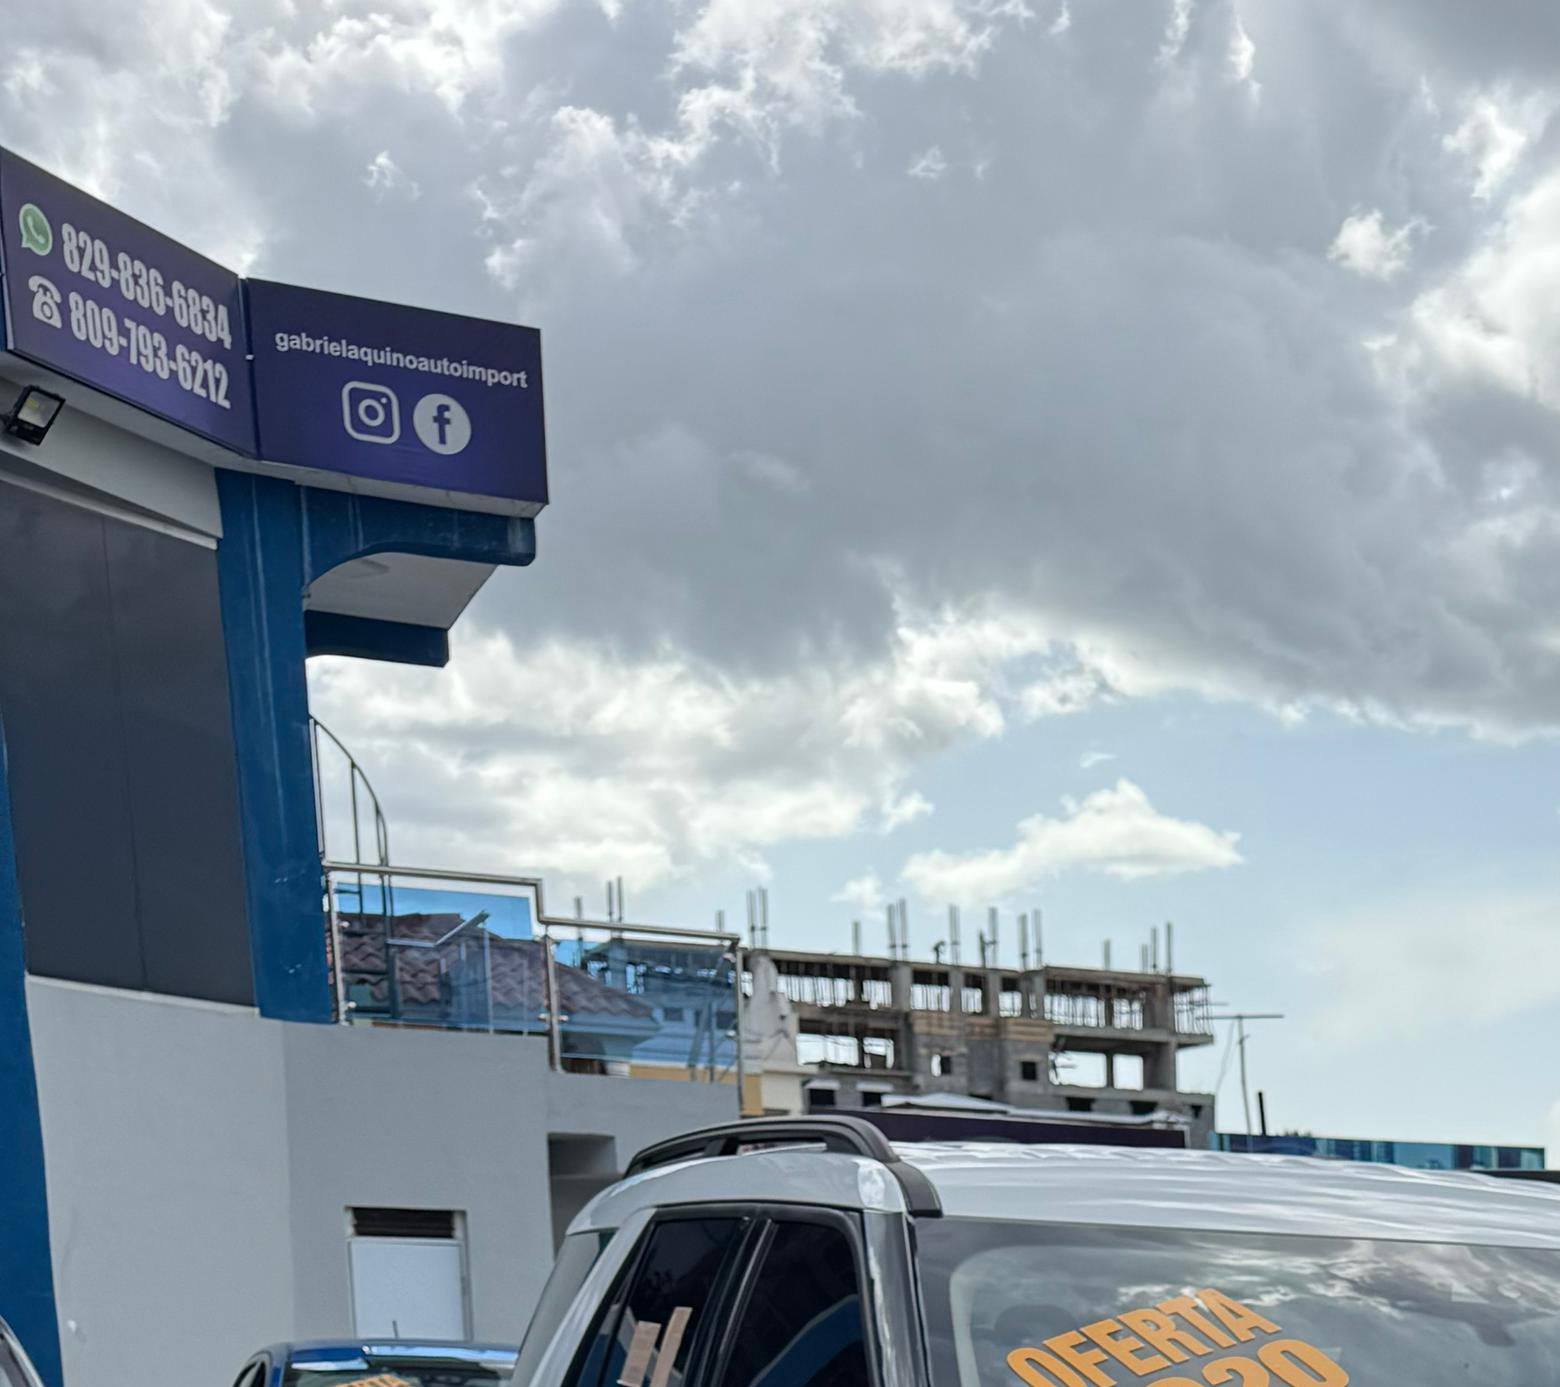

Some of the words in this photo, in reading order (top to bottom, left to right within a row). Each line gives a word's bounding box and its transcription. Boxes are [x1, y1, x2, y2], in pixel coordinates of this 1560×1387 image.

[62, 223, 232, 350] 829-836-6834
[69, 291, 231, 409] 809-793-6212
[275, 332, 528, 388] gabrielaquinoautoimport
